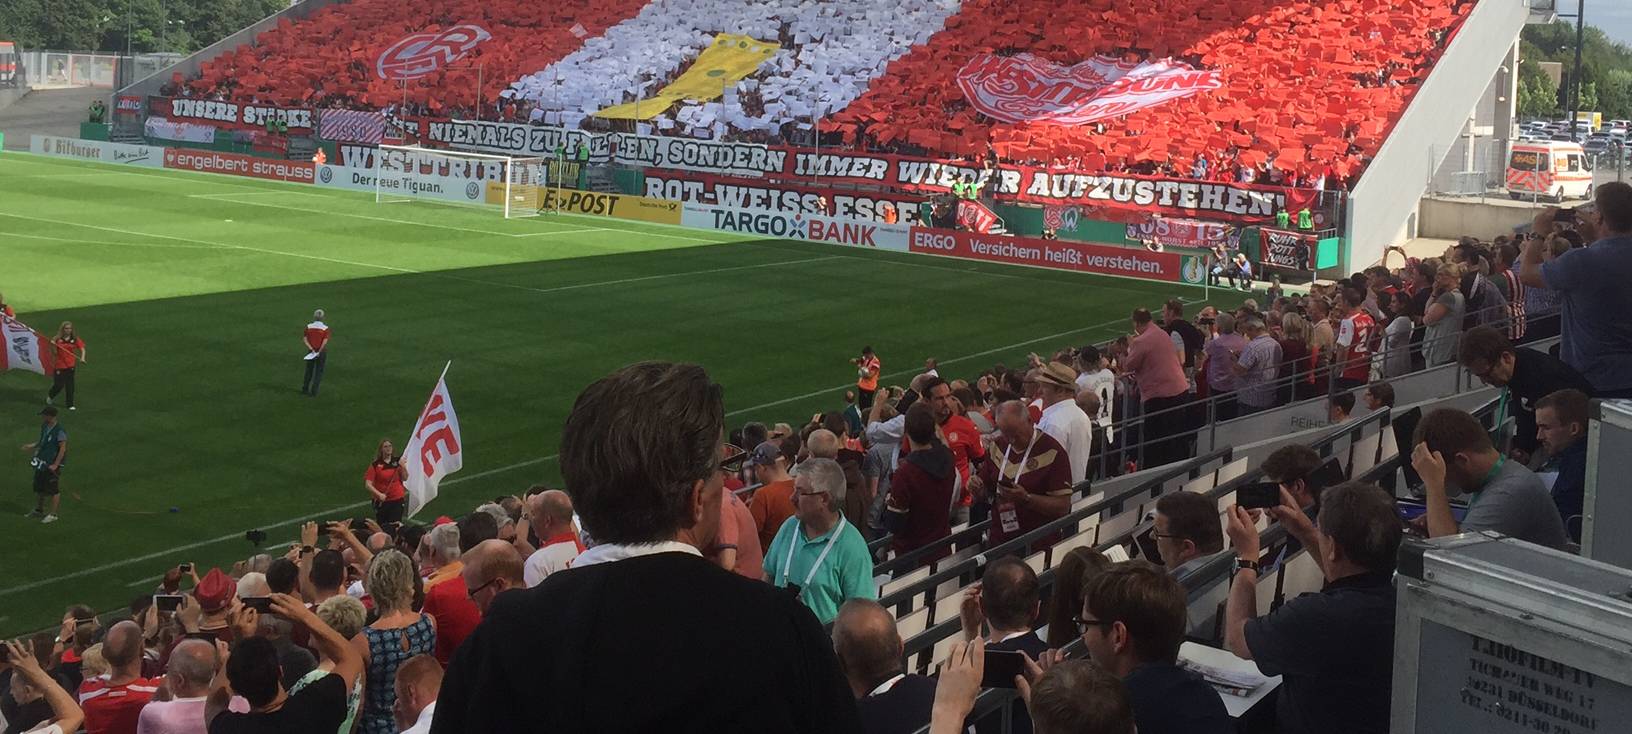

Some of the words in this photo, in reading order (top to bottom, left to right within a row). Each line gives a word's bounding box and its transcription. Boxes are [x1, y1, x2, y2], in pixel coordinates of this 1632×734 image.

[172, 99, 238, 122] UNSERE
[177, 153, 248, 172] engelbert
[252, 163, 313, 179] strauss
[428, 122, 526, 150] NIEMALS
[531, 129, 562, 152] ZU
[668, 141, 786, 173] SONDERN
[794, 153, 888, 180] IMMER
[1027, 172, 1285, 216] AUFZUSTEHEN!
[352, 172, 371, 186] Der
[373, 177, 399, 189] neue
[402, 177, 444, 194] Tiguan.
[833, 195, 920, 225] ESSE
[1269, 233, 1298, 246] RUHR
[1270, 242, 1296, 255] POTT
[914, 232, 956, 250] ERGO
[970, 239, 1040, 260] Versichern
[1045, 247, 1083, 266] heißt
[1087, 255, 1164, 274] verstehen.
